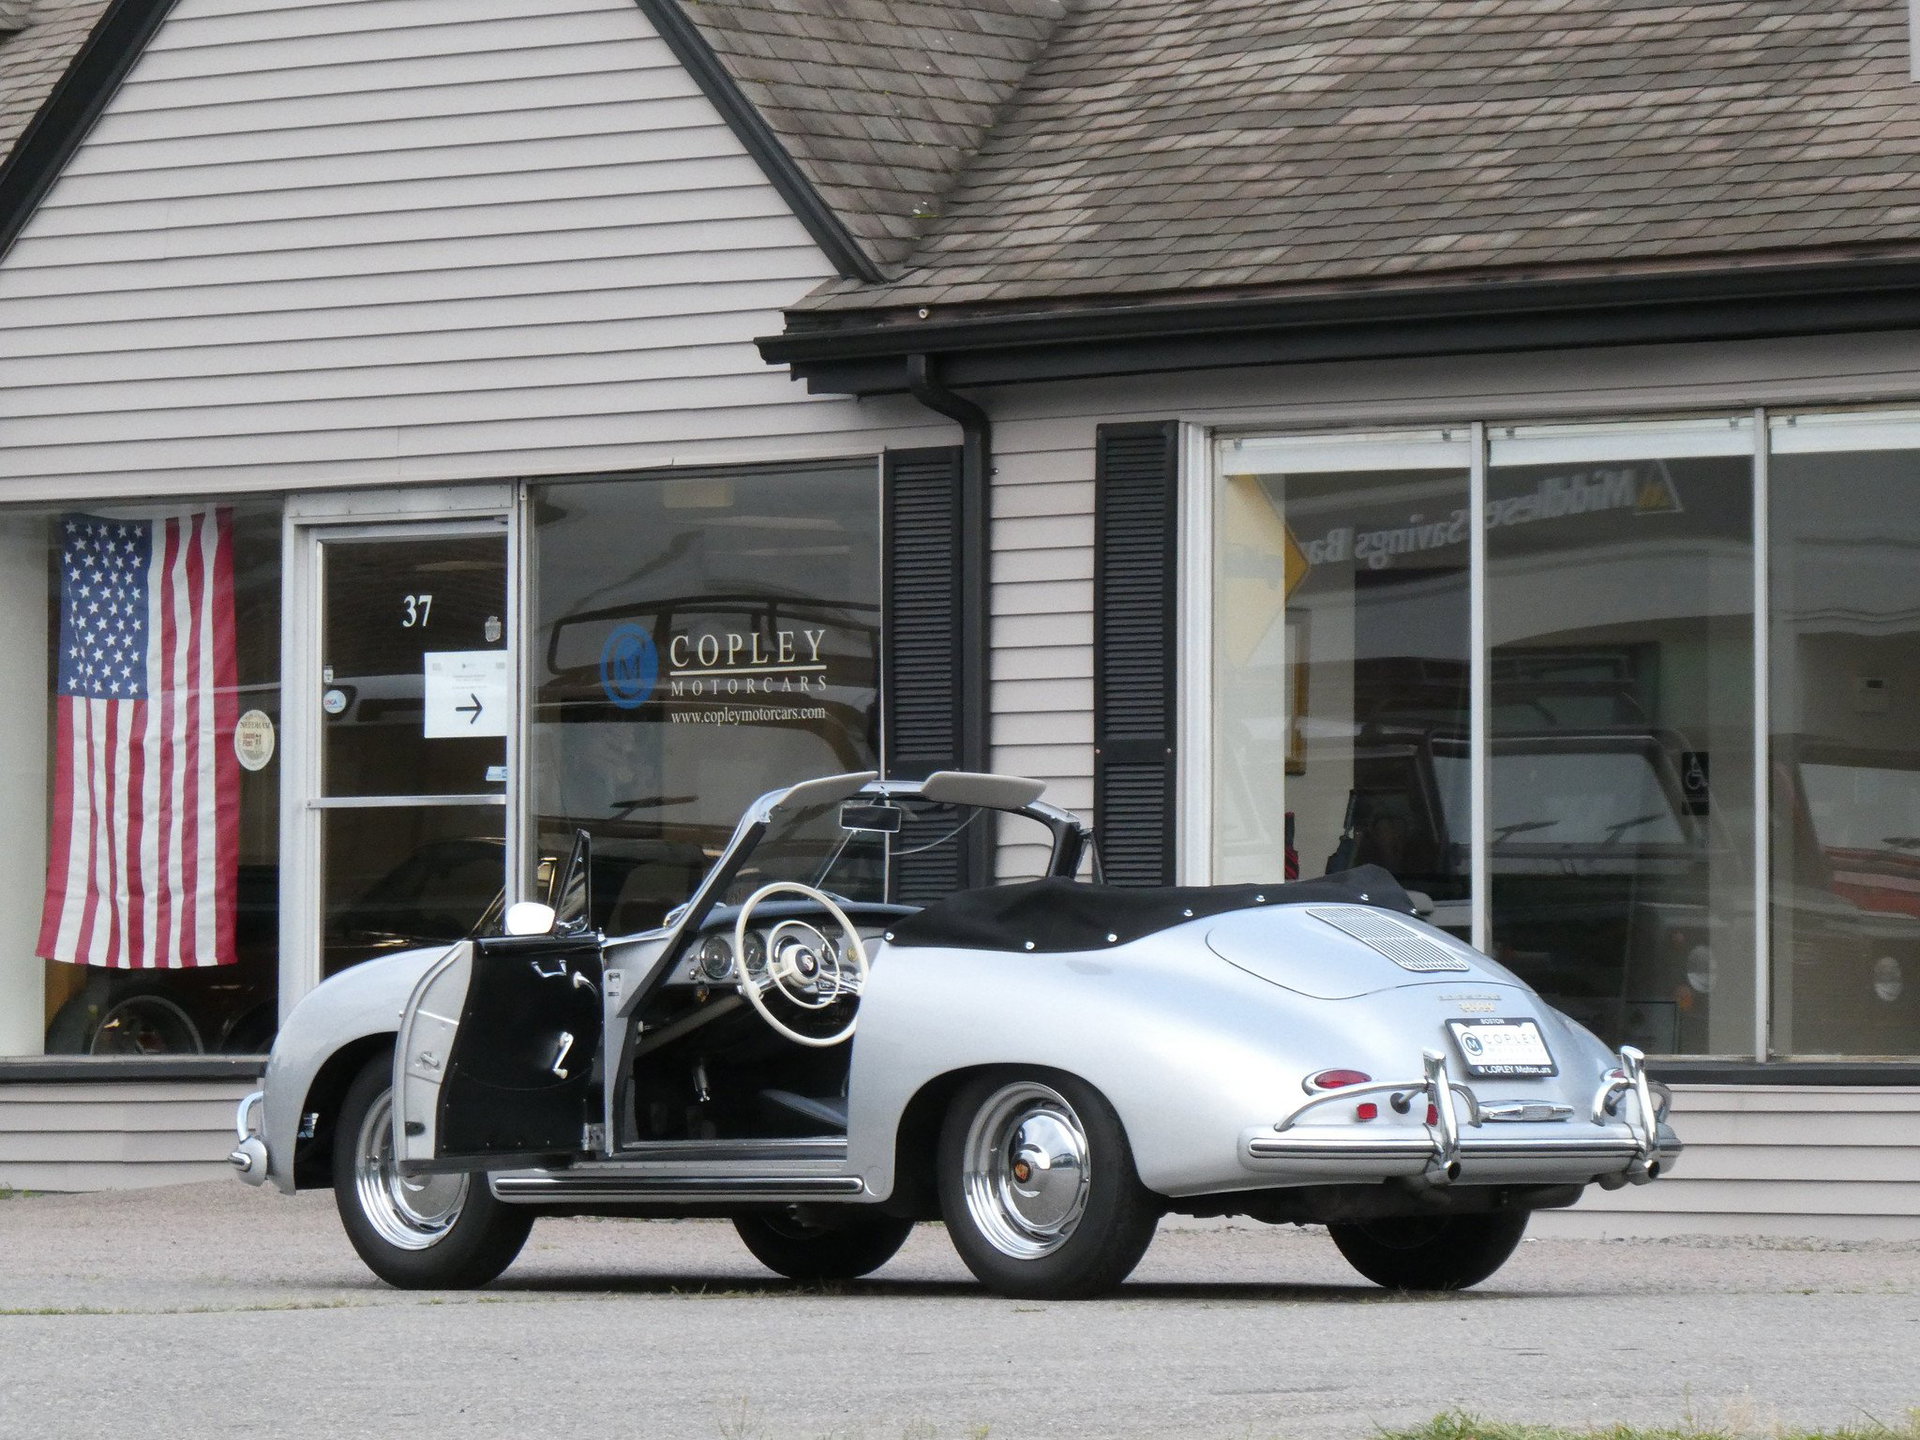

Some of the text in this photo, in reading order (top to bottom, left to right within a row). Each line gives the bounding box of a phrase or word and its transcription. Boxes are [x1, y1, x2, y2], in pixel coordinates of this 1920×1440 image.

[402, 594, 433, 628] 37
[670, 629, 826, 668] COPLEY
[670, 675, 828, 697] MOTORCARS
[670, 707, 826, 727] www.copleymotorcars.com
[1483, 1034, 1538, 1045] COPLEY
[1486, 1065, 1514, 1074] COPLEY
